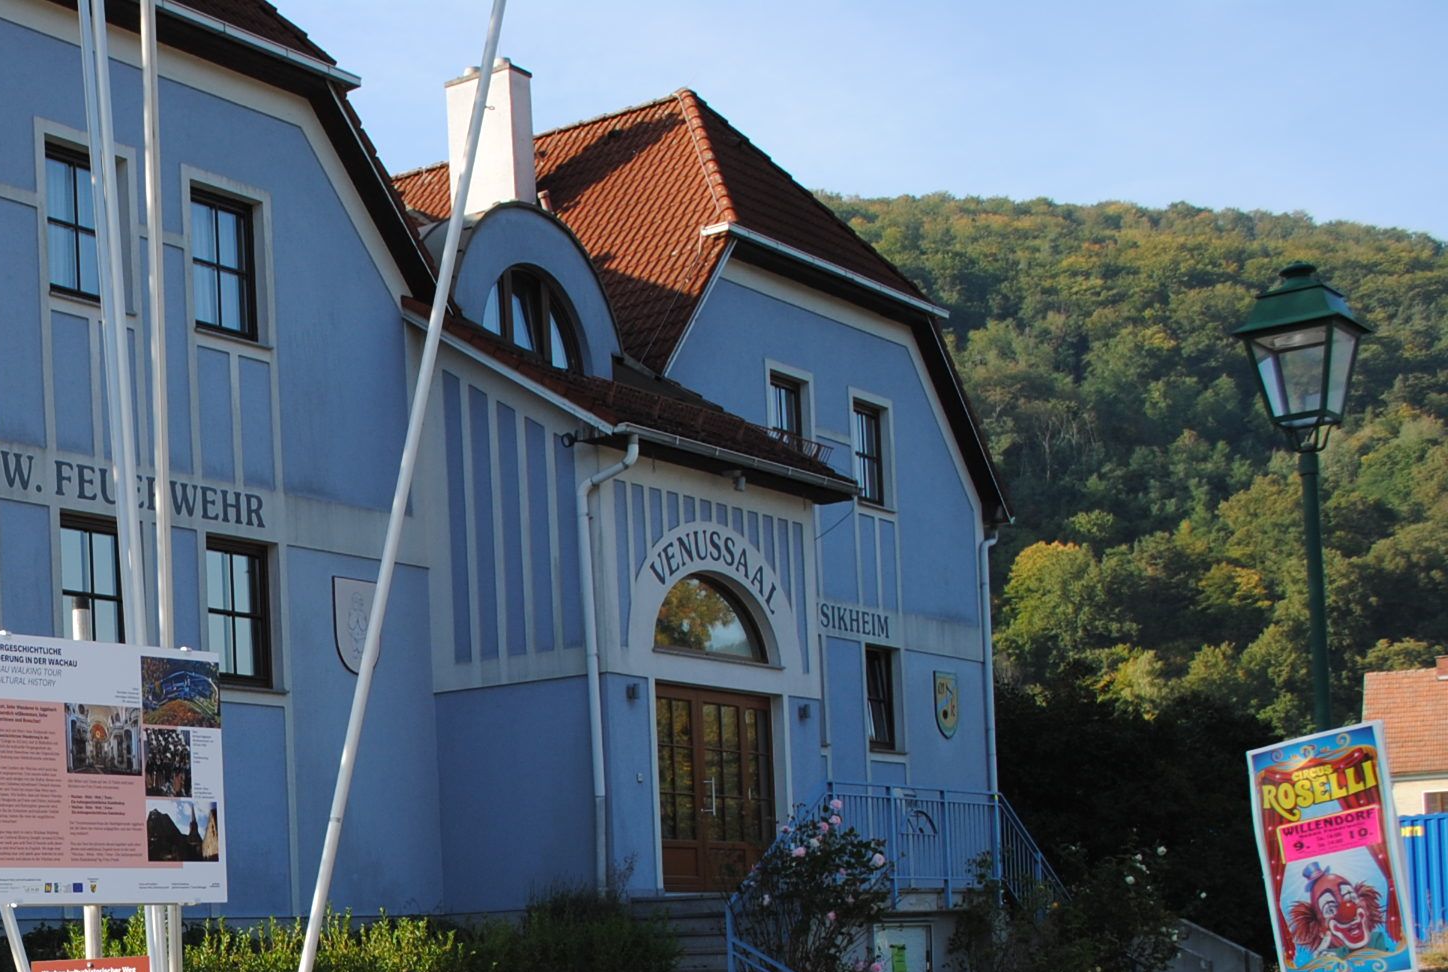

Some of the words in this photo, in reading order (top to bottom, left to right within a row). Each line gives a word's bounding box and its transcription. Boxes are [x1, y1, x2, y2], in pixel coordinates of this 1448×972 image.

[649, 529, 777, 616] VENUSSAAL
[816, 602, 890, 640] SIKHEIM
[10, 666, 42, 676] WALKING
[43, 668, 63, 677] TOUR
[33, 657, 48, 666] DER
[48, 659, 78, 668] WACHAU
[27, 678, 57, 688] HISTORY
[1291, 764, 1333, 782] CIRCUS
[1261, 759, 1377, 822] ROSELLI
[1282, 807, 1376, 837] WILLENDORF
